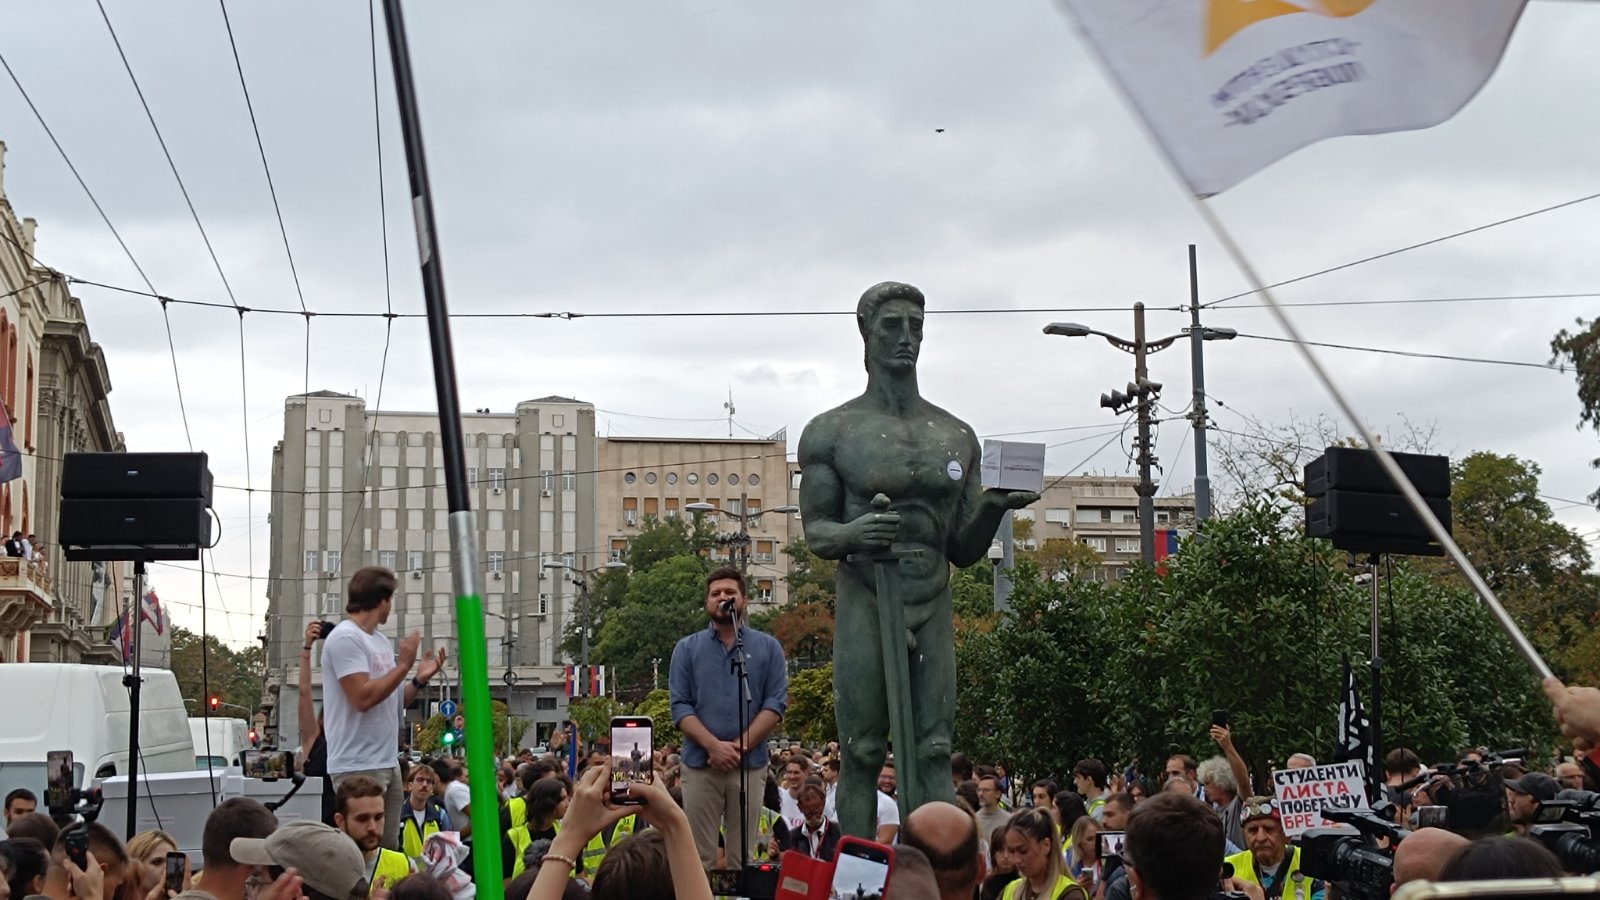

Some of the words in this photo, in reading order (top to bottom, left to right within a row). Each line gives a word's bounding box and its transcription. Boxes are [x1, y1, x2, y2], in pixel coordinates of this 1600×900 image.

[1275, 764, 1358, 785] СТУДЕНТИ
[1282, 781, 1349, 800] ЛИСТА
[1284, 814, 1315, 829] БРЕ
